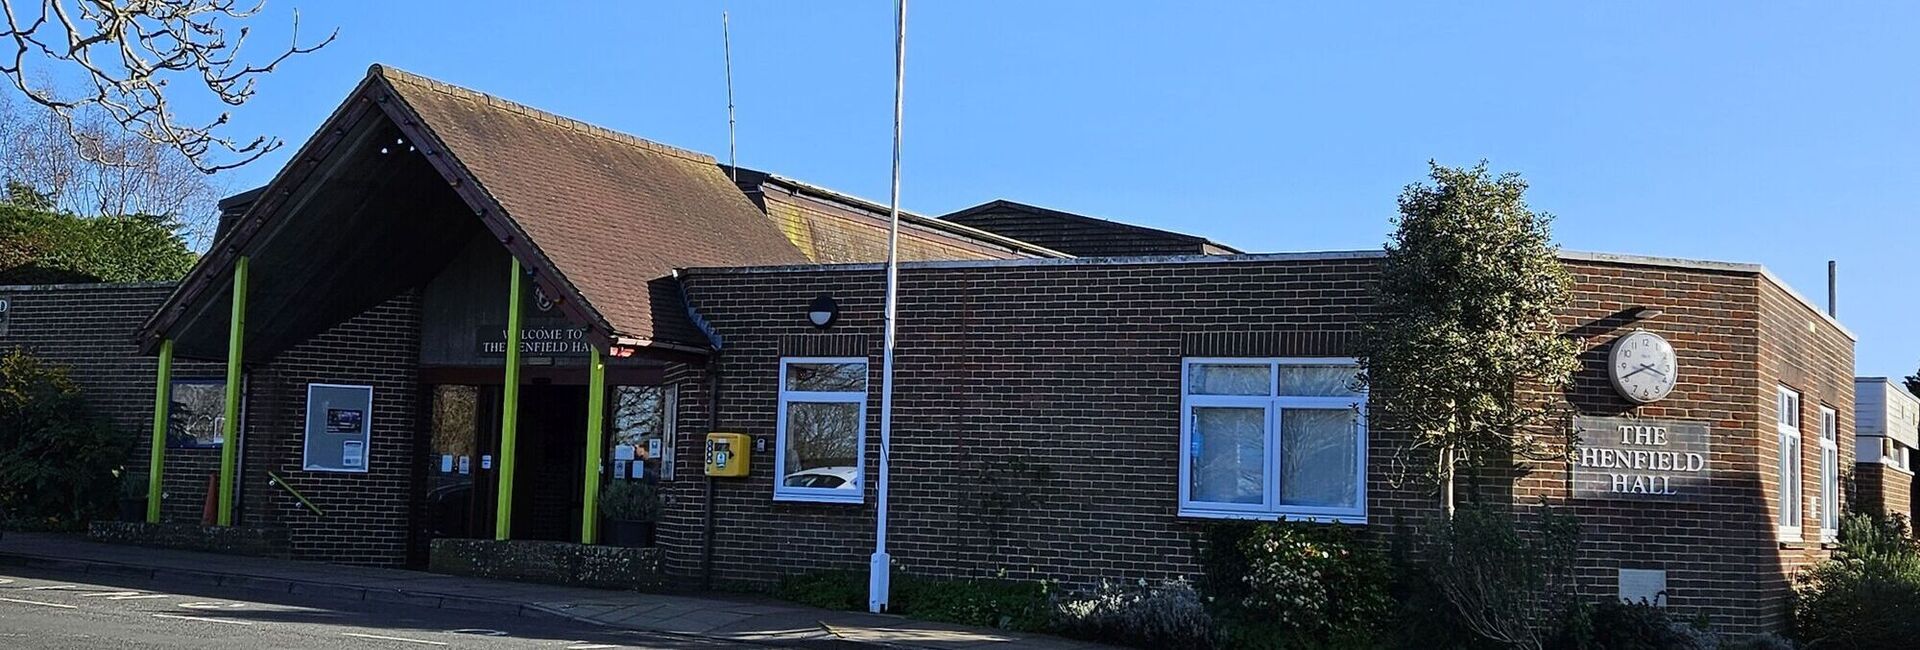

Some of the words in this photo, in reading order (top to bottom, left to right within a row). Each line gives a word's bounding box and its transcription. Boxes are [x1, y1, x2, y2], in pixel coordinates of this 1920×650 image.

[503, 329, 562, 339] LCOME
[567, 329, 583, 339] TO
[483, 342, 506, 352] THE
[519, 342, 568, 352] ENFIELD
[572, 342, 592, 352] HA
[1624, 349, 1631, 358] 10
[1632, 384, 1638, 393] 7
[1654, 386, 1660, 394] 5
[1617, 425, 1668, 446] THE
[1580, 447, 1704, 472] HENFIELD
[1609, 473, 1677, 495] HALL
